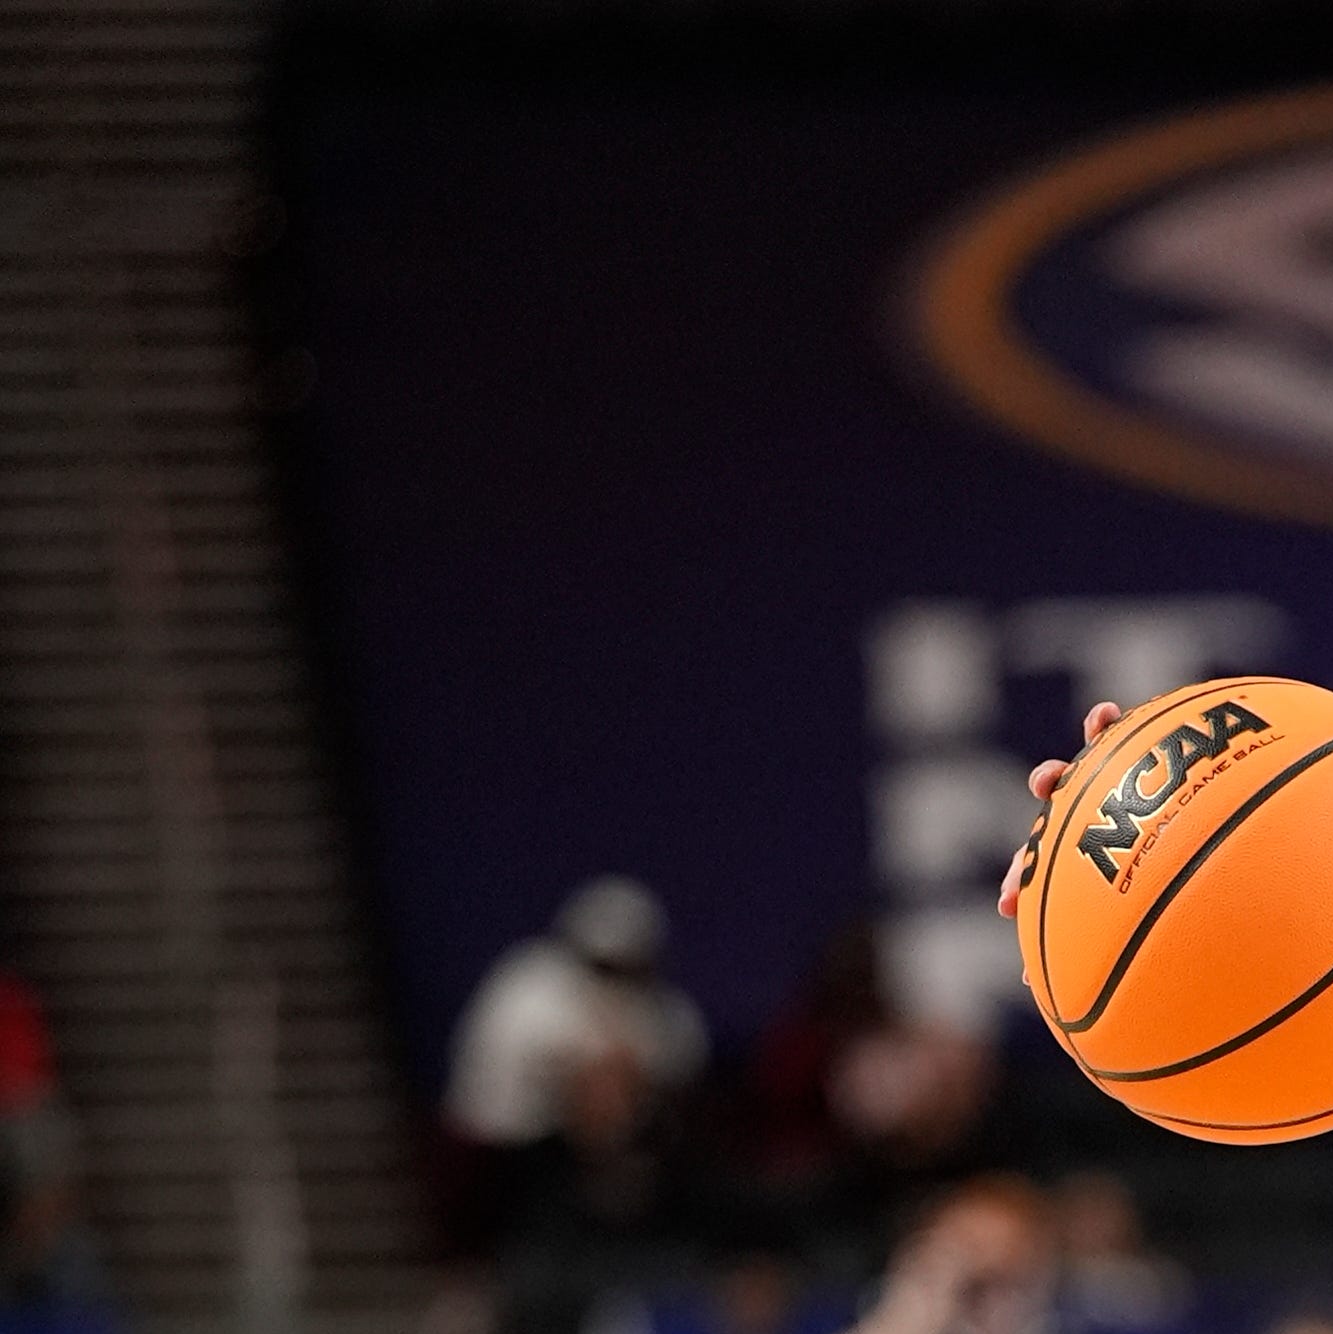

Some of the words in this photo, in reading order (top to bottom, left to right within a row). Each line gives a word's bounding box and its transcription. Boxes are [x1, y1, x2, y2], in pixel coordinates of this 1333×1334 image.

[1077, 701, 1272, 885] NCAA
[1119, 808, 1179, 895] OFFICIAL
[1178, 758, 1231, 806] GAME
[1234, 733, 1285, 762] BALL
